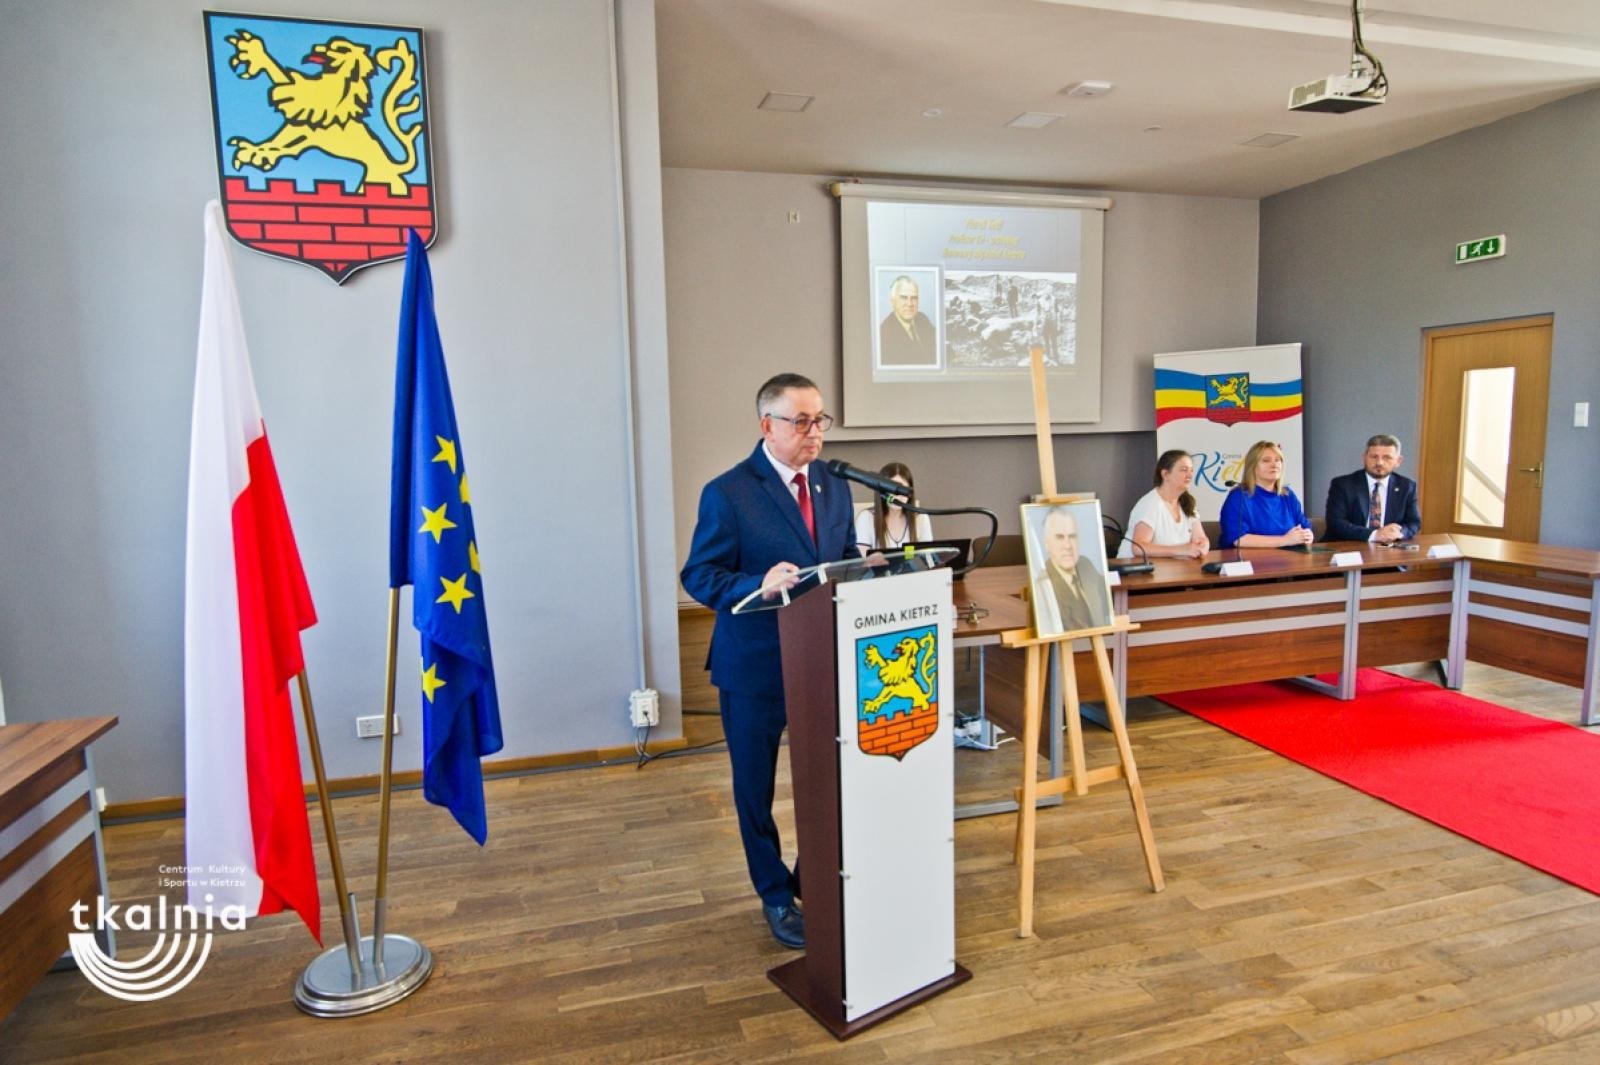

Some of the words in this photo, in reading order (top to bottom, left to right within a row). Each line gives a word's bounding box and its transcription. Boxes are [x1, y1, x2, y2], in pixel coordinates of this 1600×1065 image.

[1191, 451, 1246, 493] Kiet
[854, 612, 896, 630] GMINA
[900, 604, 938, 621] KIETRZ
